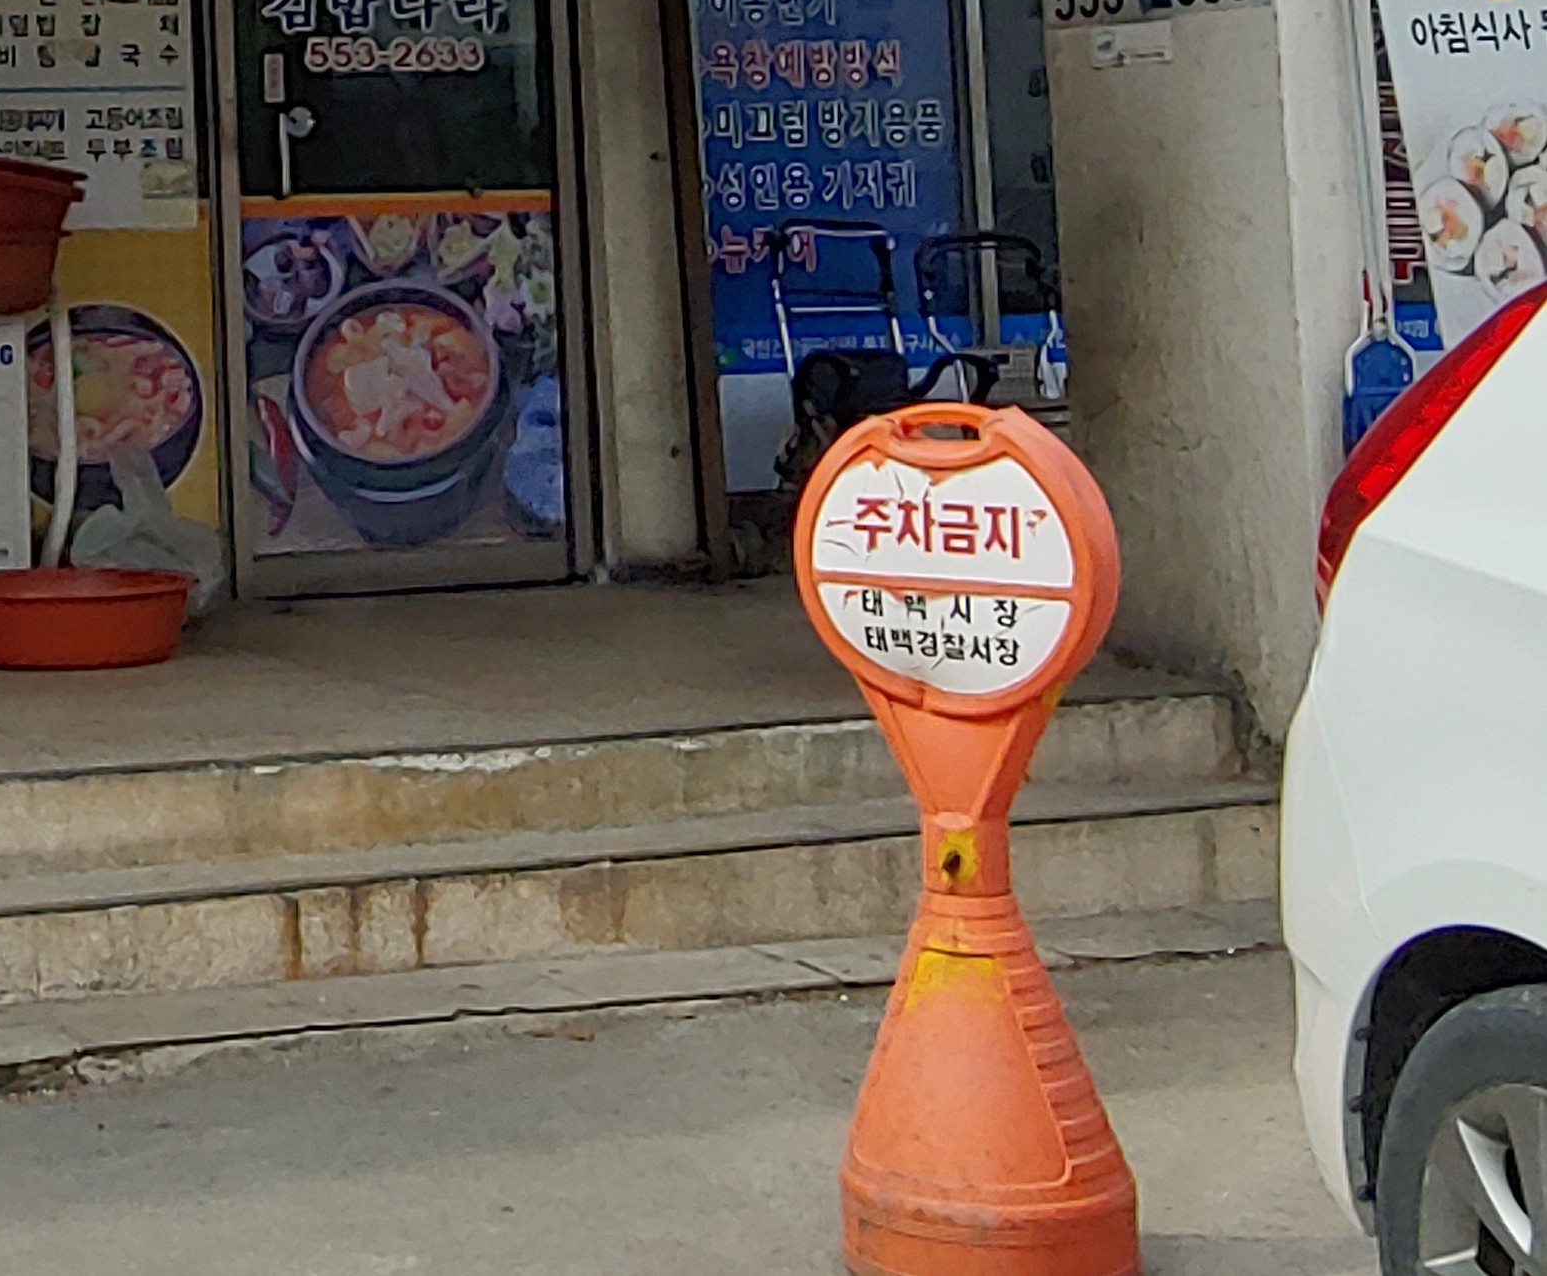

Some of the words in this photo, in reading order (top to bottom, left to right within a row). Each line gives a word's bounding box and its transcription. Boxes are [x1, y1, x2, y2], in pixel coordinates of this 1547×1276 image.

[303, 35, 486, 74] 553-2633
[1410, 9, 1532, 56] 아침식사
[818, 98, 945, 148] 방지용품
[716, 160, 815, 211] 성인용
[853, 495, 1022, 560] 주차금지
[864, 624, 1021, 667] 태백경찰서장
